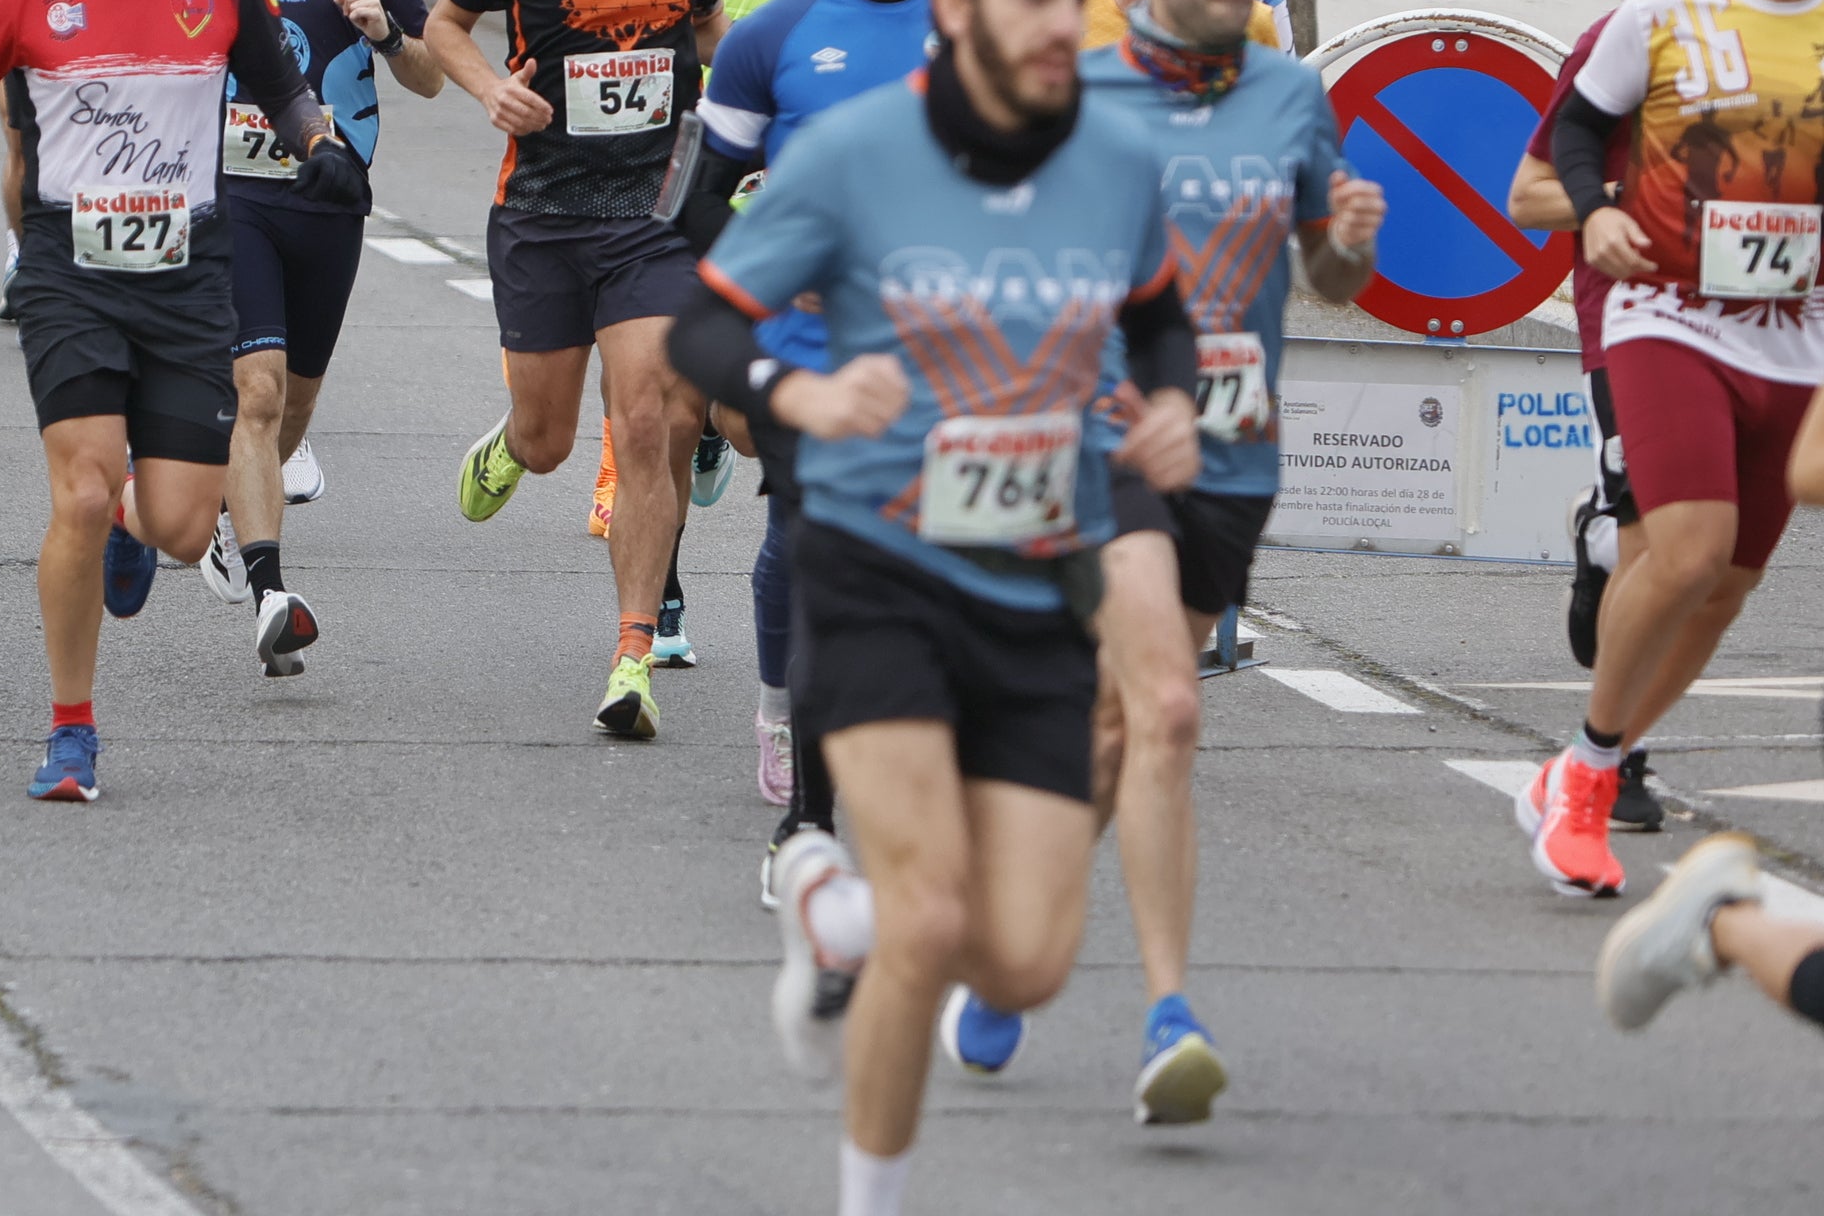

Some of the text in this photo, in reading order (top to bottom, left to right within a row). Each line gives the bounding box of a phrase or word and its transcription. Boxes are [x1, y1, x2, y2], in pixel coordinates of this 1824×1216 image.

[568, 54, 671, 79] bedunia
[70, 81, 149, 134] Simón
[600, 78, 647, 115] 54
[96, 129, 192, 183] Martín
[76, 190, 186, 214] bedunia
[96, 214, 172, 252] 127
[1709, 208, 1818, 235] bedunia
[1741, 235, 1792, 275] 74
[1498, 391, 1588, 416] POLICI
[1312, 432, 1405, 448] RESERVADO
[1504, 424, 1593, 449] LOCAL
[1278, 454, 1452, 473] CTIVIDAD AUTORIZADA
[1279, 485, 1445, 500] esde las 22:00 horas del día 28 de
[1272, 501, 1457, 516] viembre hasta finalización de evento.
[1322, 515, 1392, 528] POLICÍA LOCAL
